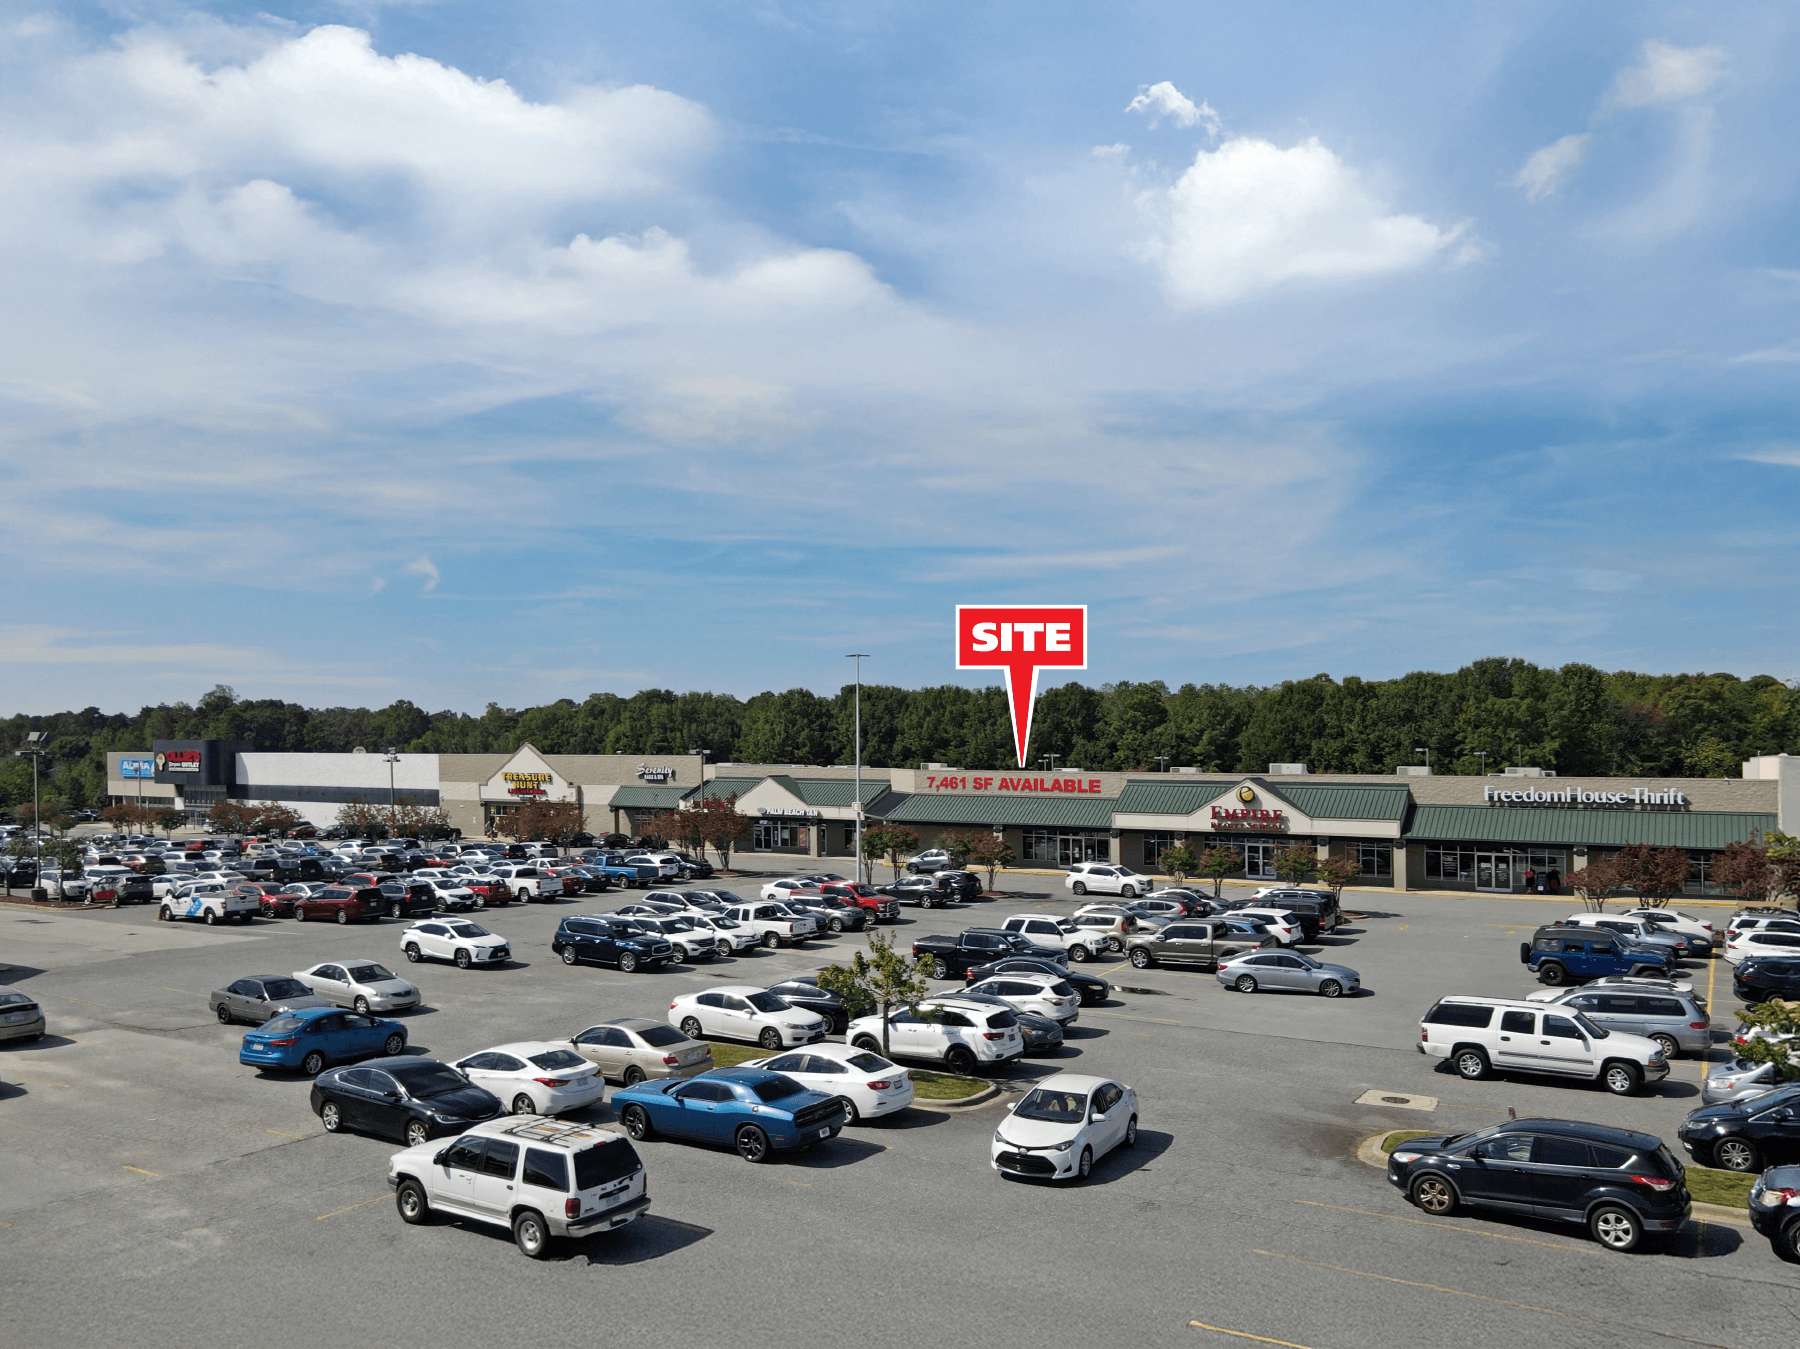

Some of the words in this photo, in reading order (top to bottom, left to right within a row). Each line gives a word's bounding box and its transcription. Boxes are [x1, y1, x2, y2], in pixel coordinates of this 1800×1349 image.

[501, 772, 552, 781] TREASURE
[635, 763, 673, 778] Serenity
[512, 781, 539, 789] HUNT
[1631, 787, 1685, 805] Thrift
[784, 808, 805, 816] BEACH
[805, 809, 819, 817] TAN
[1210, 805, 1283, 822] EMPIRE
